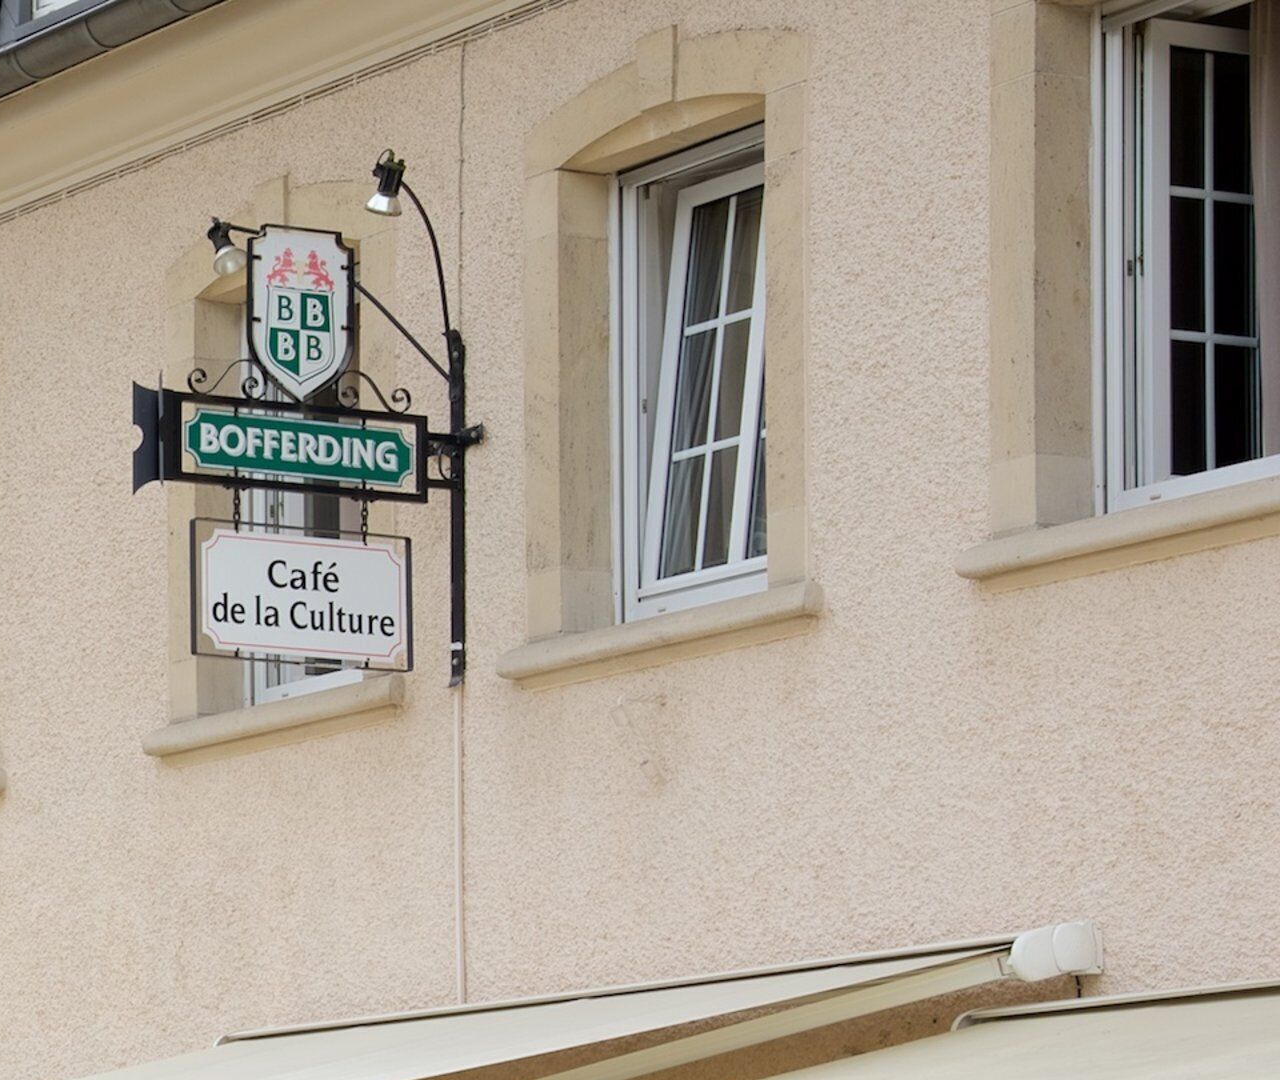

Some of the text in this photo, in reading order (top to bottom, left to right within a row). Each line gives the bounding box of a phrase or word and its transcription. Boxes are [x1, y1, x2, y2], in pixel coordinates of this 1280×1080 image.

[277, 295, 325, 327] B B
[277, 332, 322, 361] B B
[199, 421, 399, 473] BOFFERDING
[267, 560, 340, 594] Café
[212, 593, 396, 637] de la Culture
